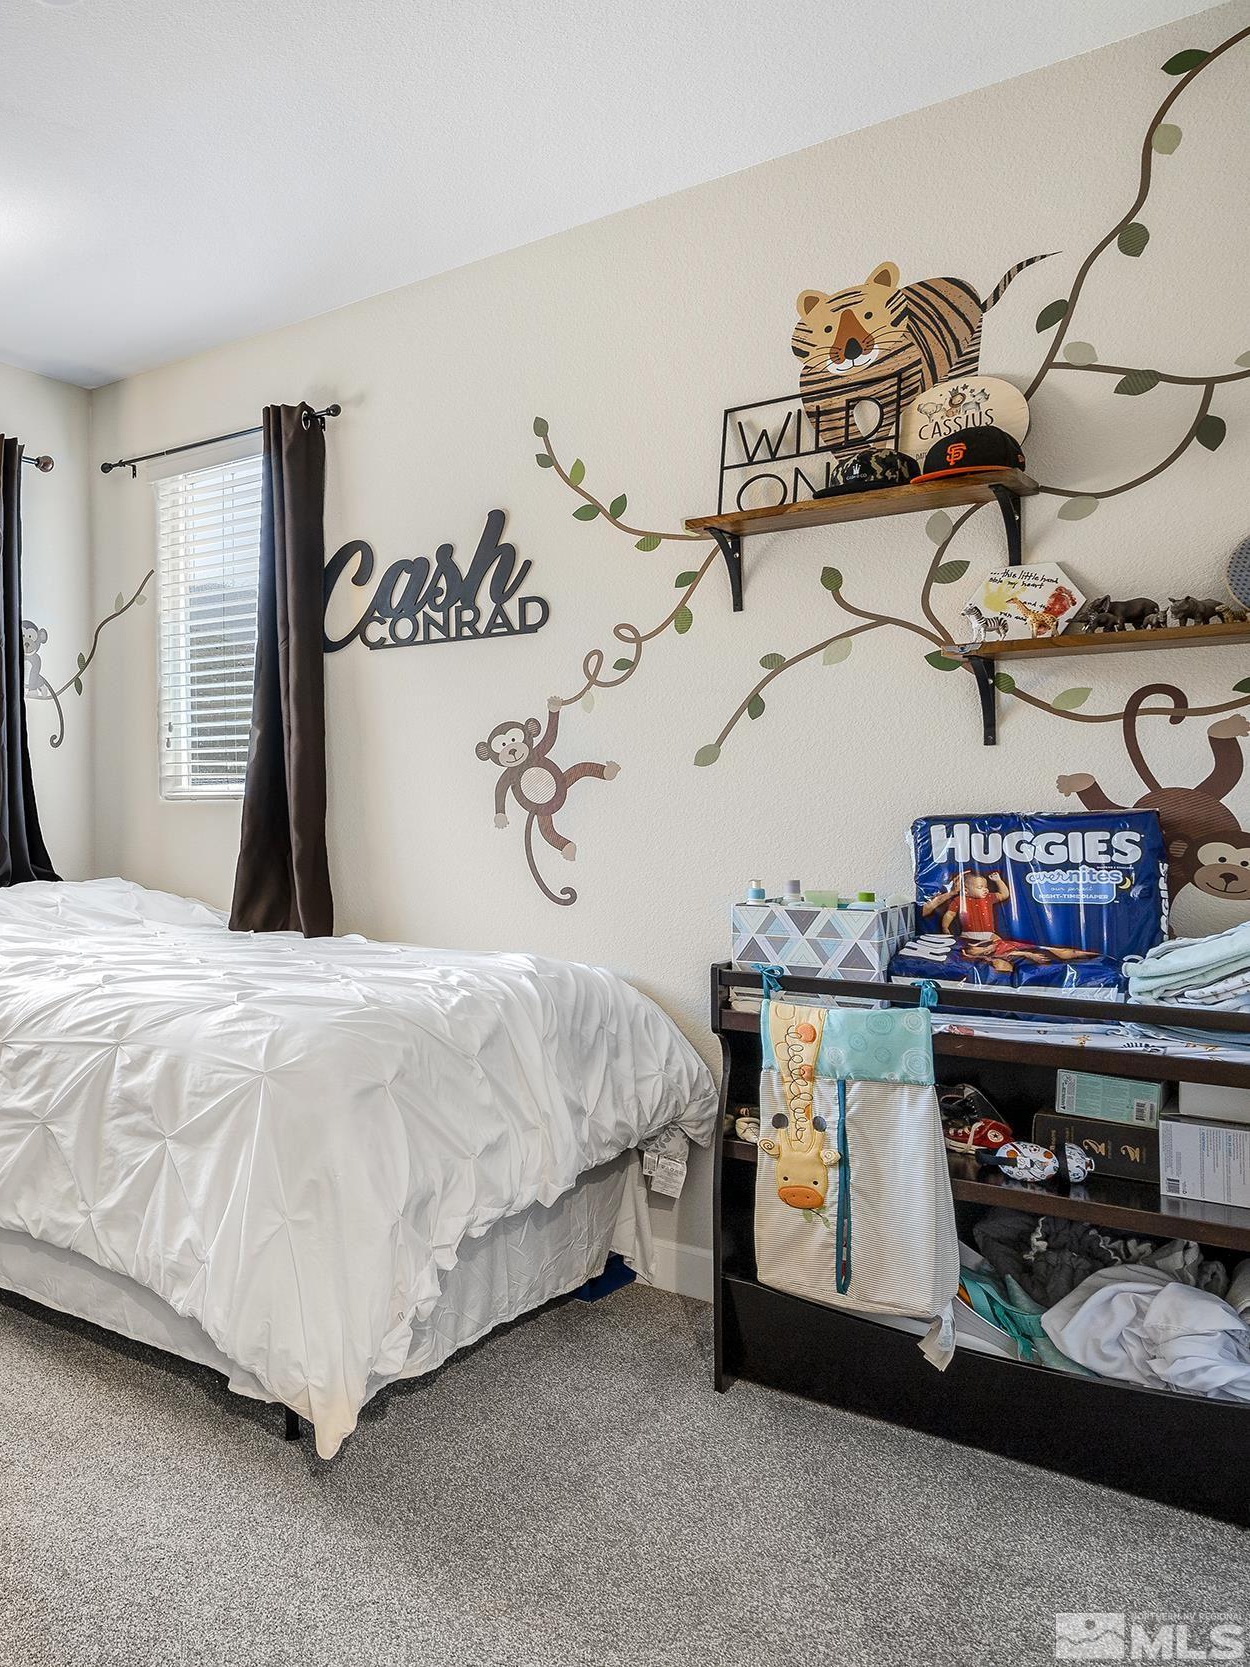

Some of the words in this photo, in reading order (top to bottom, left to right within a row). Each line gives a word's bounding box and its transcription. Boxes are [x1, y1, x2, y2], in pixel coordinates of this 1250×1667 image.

[737, 396, 884, 464] WILD
[918, 408, 994, 441] CASSIUS
[736, 462, 831, 512] ON
[323, 509, 532, 653] Cash
[1007, 580, 1018, 589] my
[1021, 581, 1044, 589] heart
[1018, 570, 1039, 581] little
[1040, 575, 1059, 584] hand
[359, 595, 550, 649] CONRAD
[930, 823, 1142, 864] HUGGIES
[1028, 867, 1122, 883] overnites
